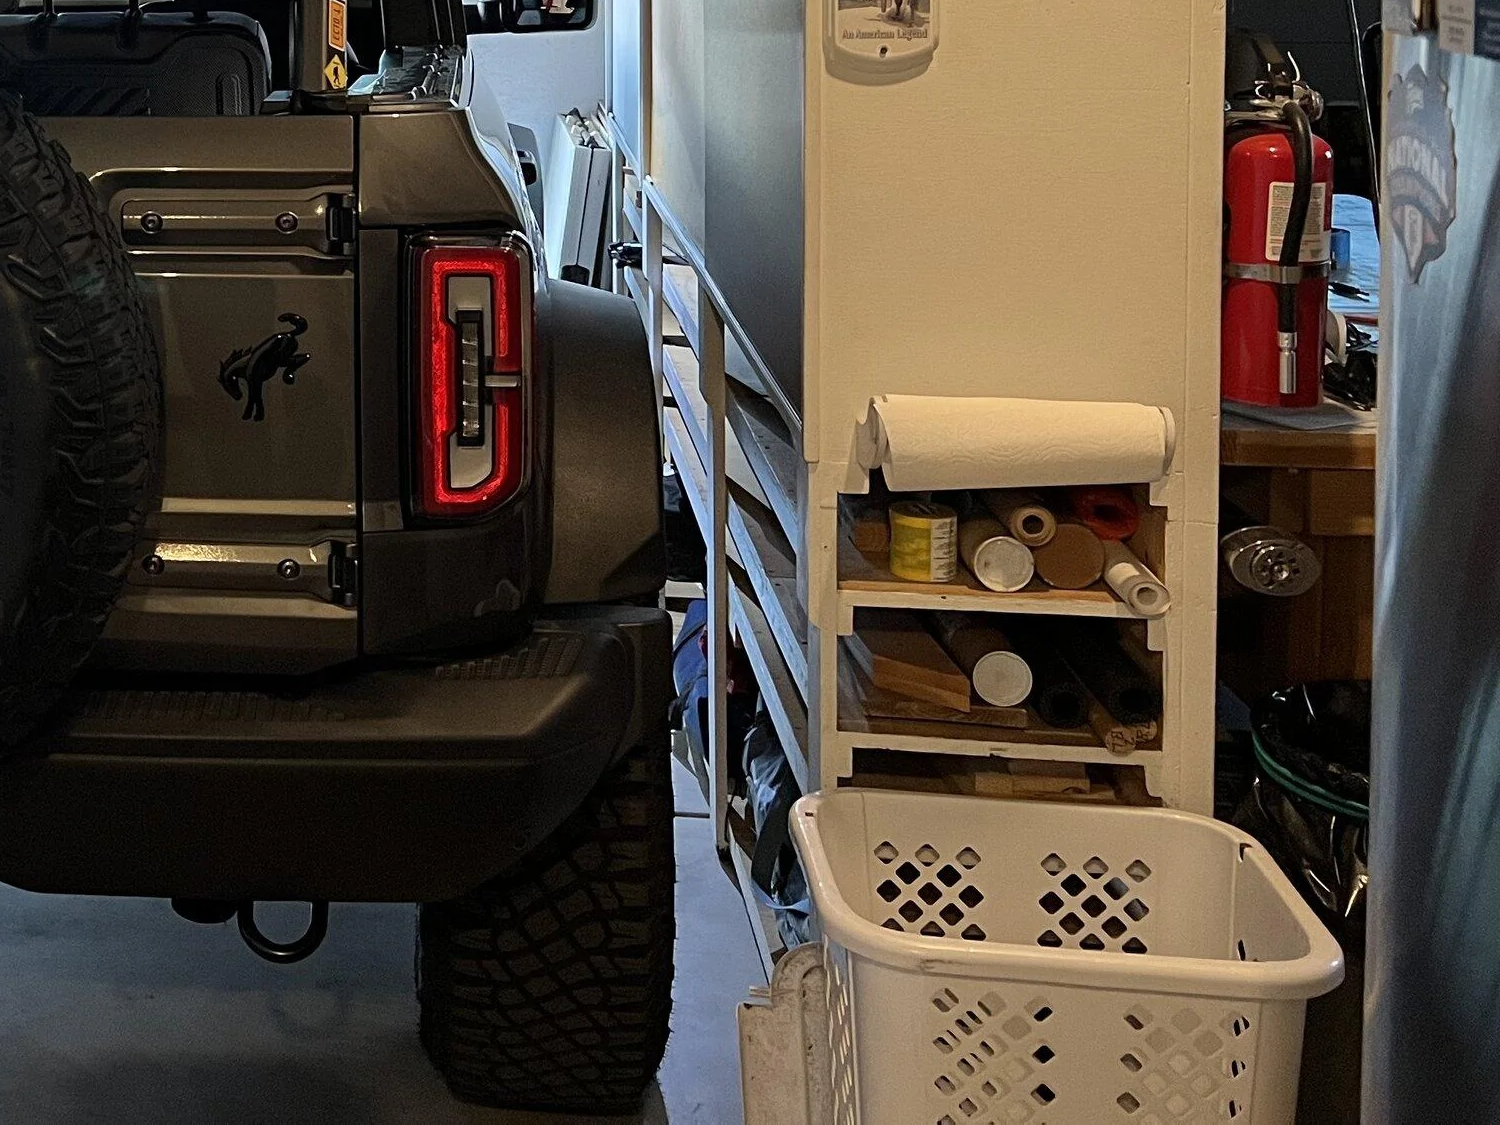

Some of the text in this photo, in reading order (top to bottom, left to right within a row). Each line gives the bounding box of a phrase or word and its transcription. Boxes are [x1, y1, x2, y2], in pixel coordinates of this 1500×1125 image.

[842, 28, 928, 41] An American Legend
